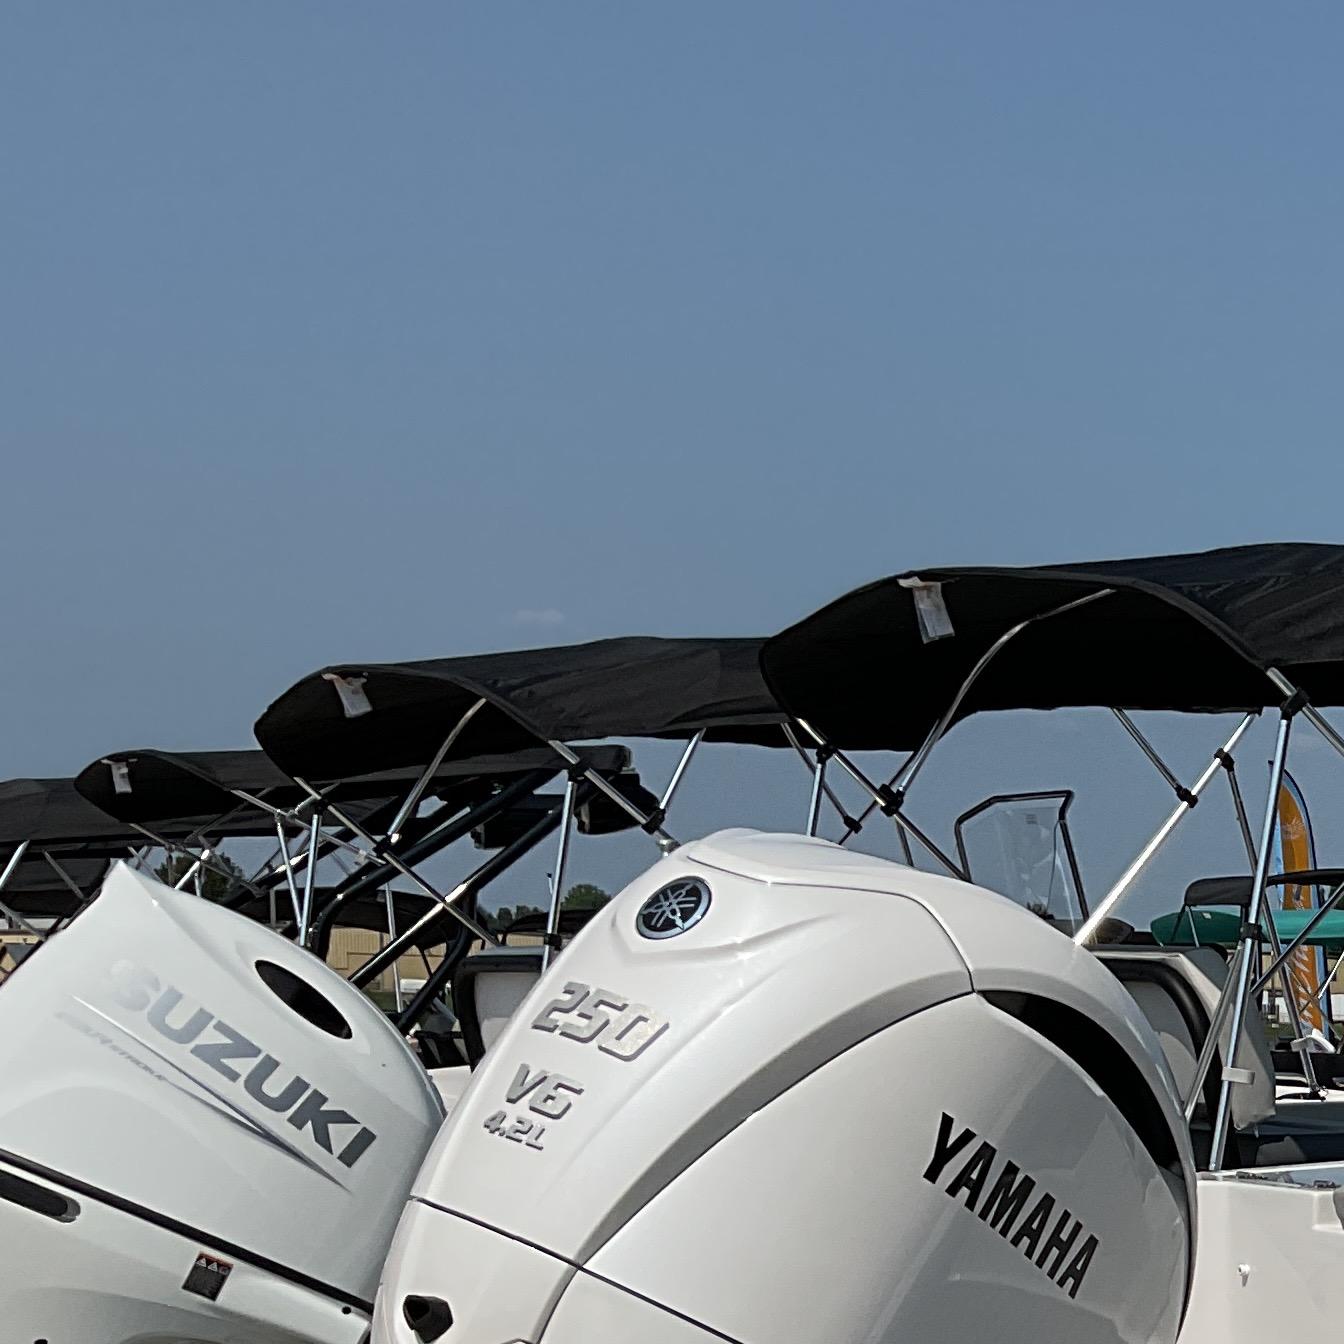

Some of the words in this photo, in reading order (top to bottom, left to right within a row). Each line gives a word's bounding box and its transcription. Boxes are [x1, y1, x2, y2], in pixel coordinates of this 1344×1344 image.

[531, 981, 670, 1062] 250
[109, 957, 377, 1169] SUZUKI
[505, 1063, 585, 1120] V6
[483, 1110, 546, 1151] 4.2L
[922, 1111, 1100, 1300] YAMAHA
